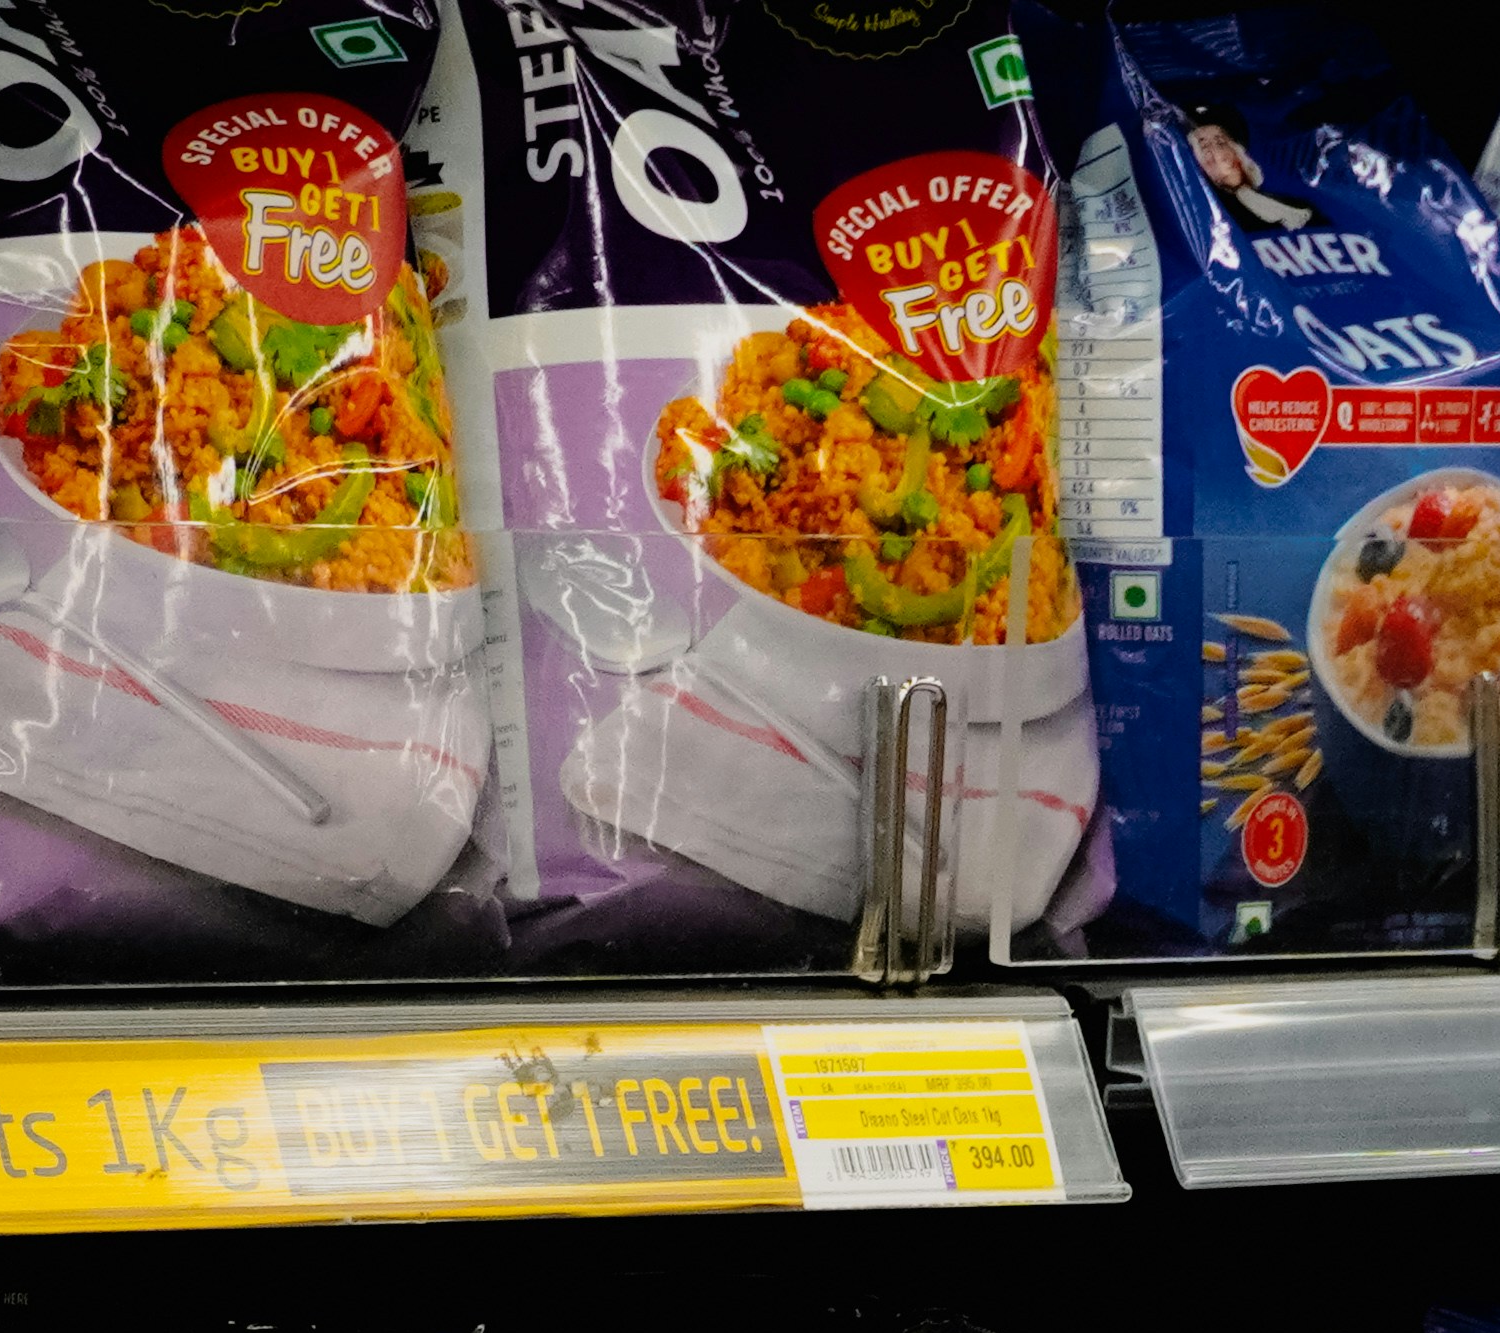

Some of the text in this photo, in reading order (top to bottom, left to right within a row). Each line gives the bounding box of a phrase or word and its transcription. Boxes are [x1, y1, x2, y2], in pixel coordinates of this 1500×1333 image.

[180, 107, 288, 165] SPECIAL
[298, 107, 395, 180] OFFER
[231, 145, 318, 178] BUY
[299, 189, 364, 220] GET
[827, 175, 1034, 261] SPECIAL OFFER
[239, 187, 378, 293] Free
[866, 227, 952, 274] BUY
[939, 250, 1013, 293] GET
[882, 276, 1038, 355] Free
[813, 1057, 866, 1074] 1971597
[86, 1085, 261, 1192] 1Kg
[464, 1078, 561, 1161] GET
[570, 1077, 604, 1159] 1
[617, 1074, 767, 1157] FREE!
[969, 1145, 1035, 1169] 394.00
